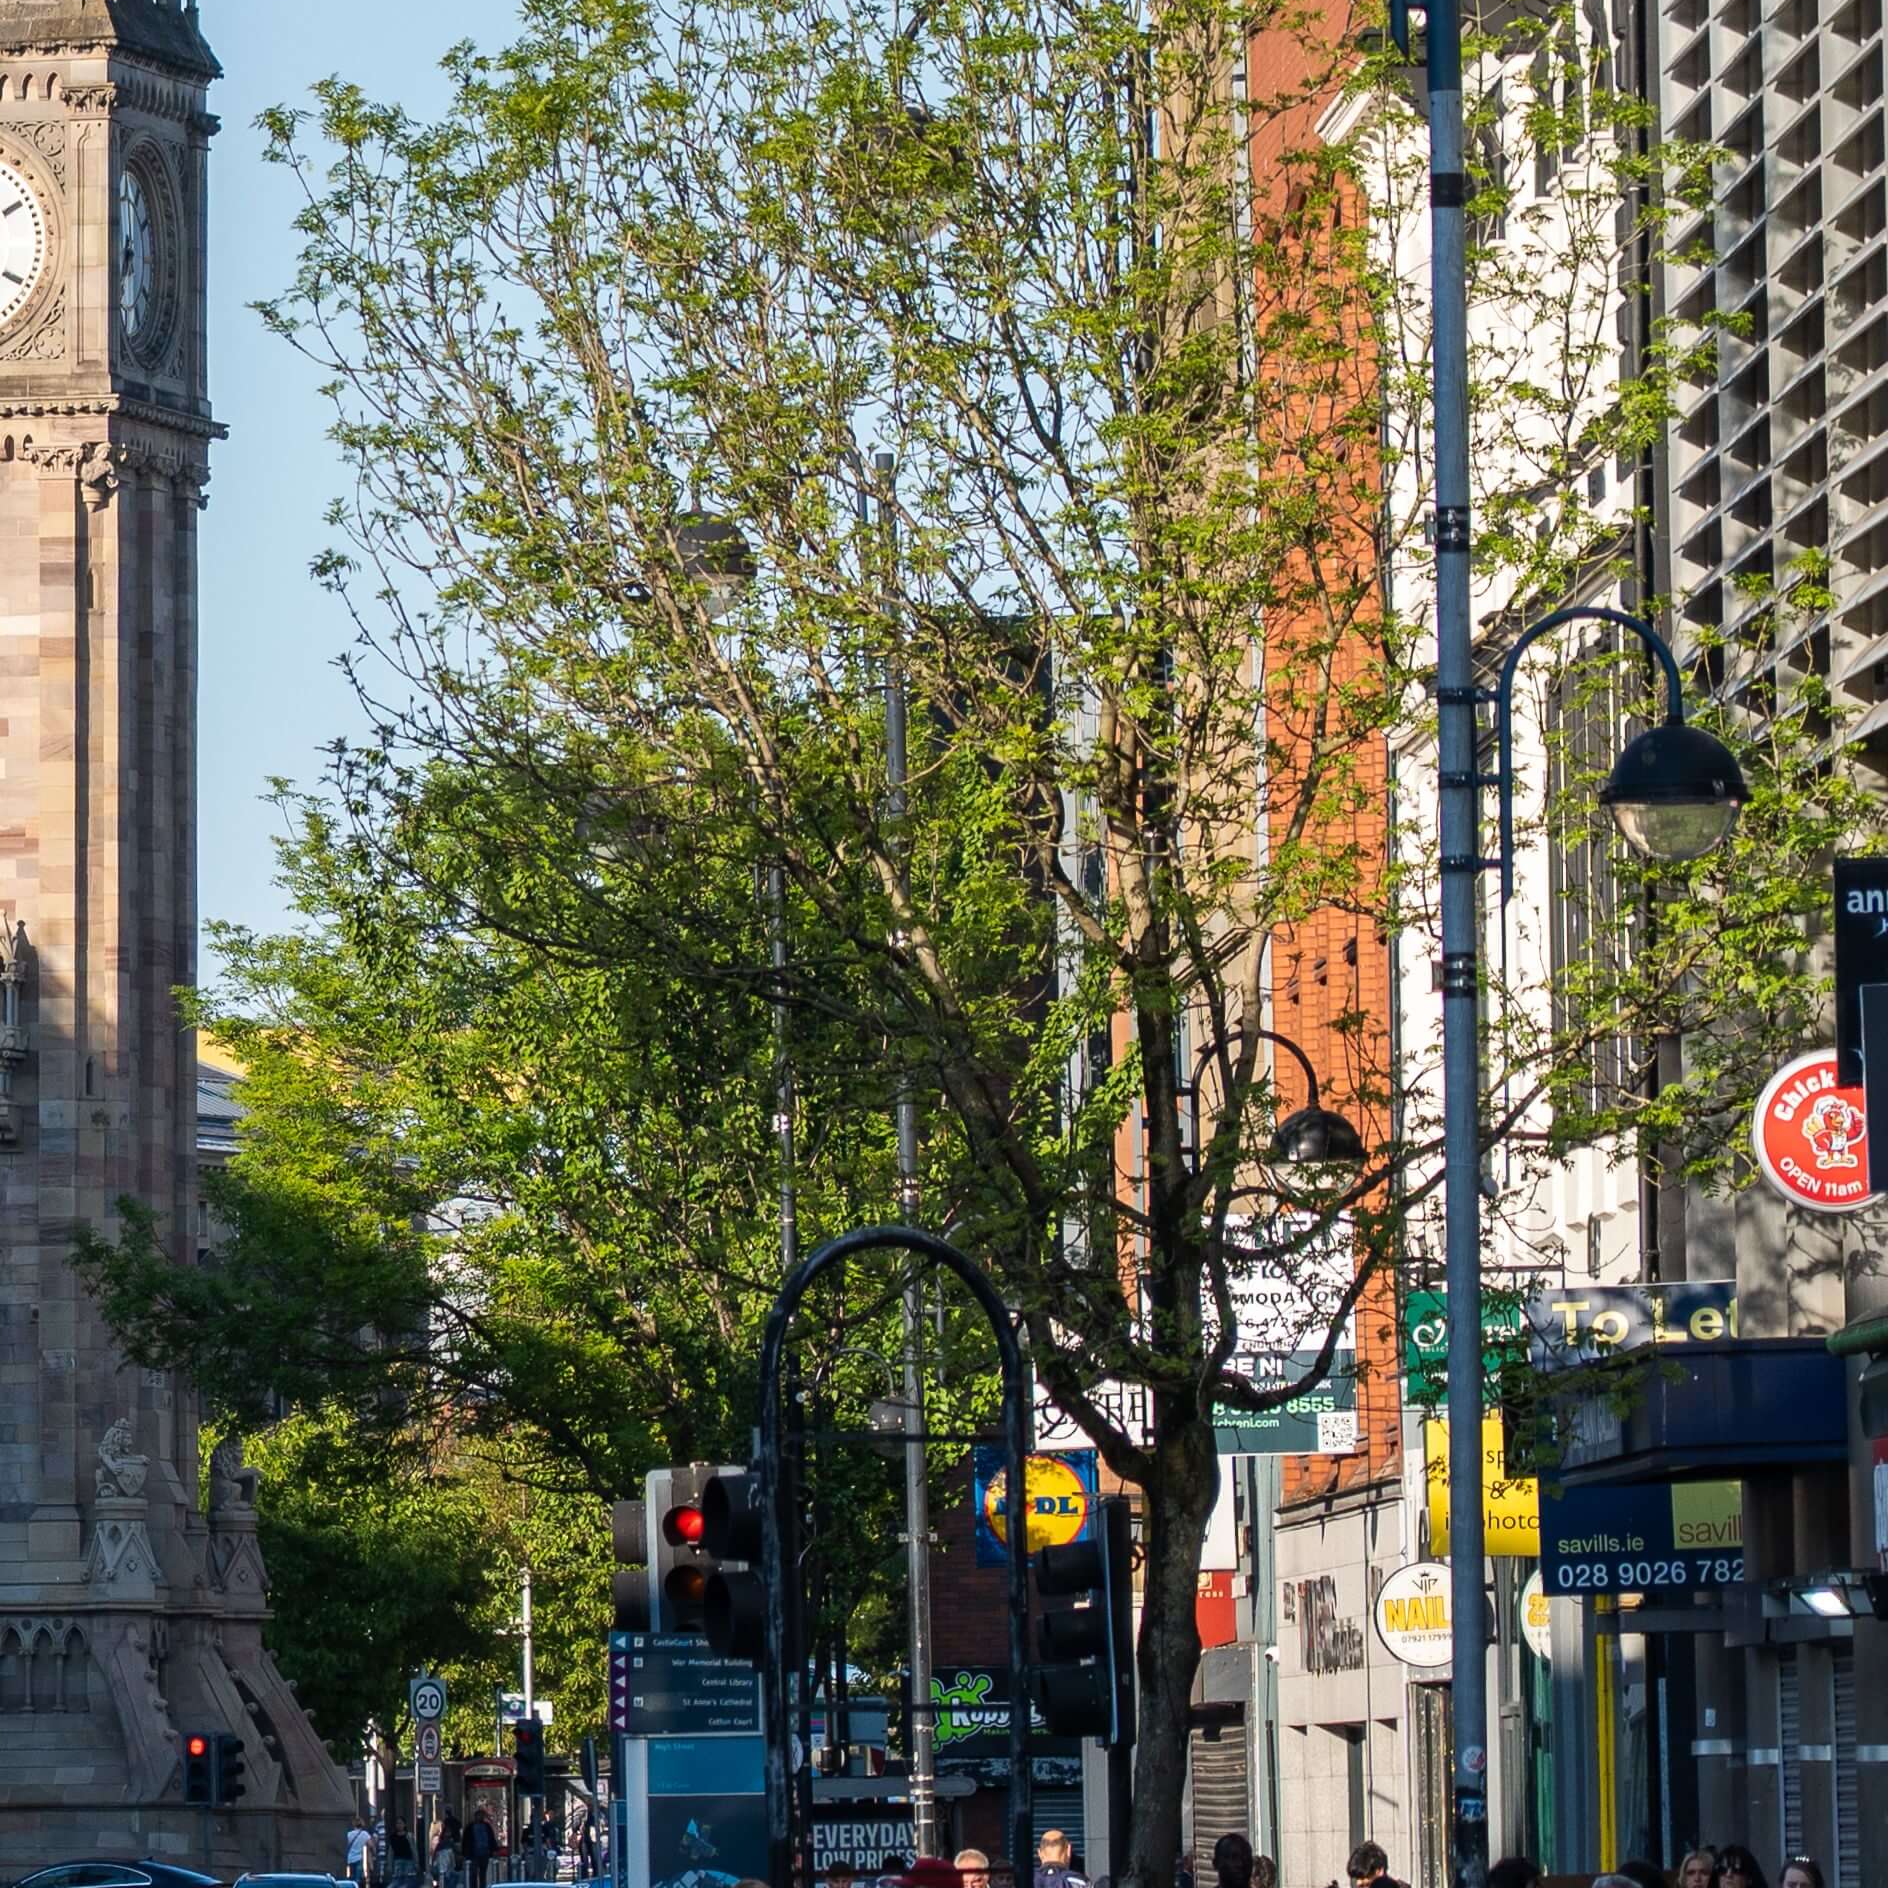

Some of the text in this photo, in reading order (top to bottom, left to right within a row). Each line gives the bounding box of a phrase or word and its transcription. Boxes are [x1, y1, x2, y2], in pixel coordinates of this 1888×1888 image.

[1846, 889, 1888, 914] an
[1773, 1068, 1836, 1122] Chick
[1780, 1157, 1862, 1197] OPEN 11am
[1551, 1300, 1629, 1345] To
[1653, 1297, 1739, 1343] Let
[1259, 1357, 1283, 1376] NI
[1286, 1396, 1335, 1414] 8555
[992, 1495, 1079, 1516] LDL
[1678, 1514, 1742, 1544] savill
[1557, 1532, 1645, 1554] savills.ie
[1558, 1558, 1745, 1588] 028 9026 782
[1384, 1595, 1452, 1633] NAIL
[688, 1658, 722, 1667] Memorial
[701, 1677, 753, 1688] Central Library
[417, 1693, 440, 1711] 20
[719, 1697, 753, 1706] Cathedral
[733, 1717, 753, 1726] Court
